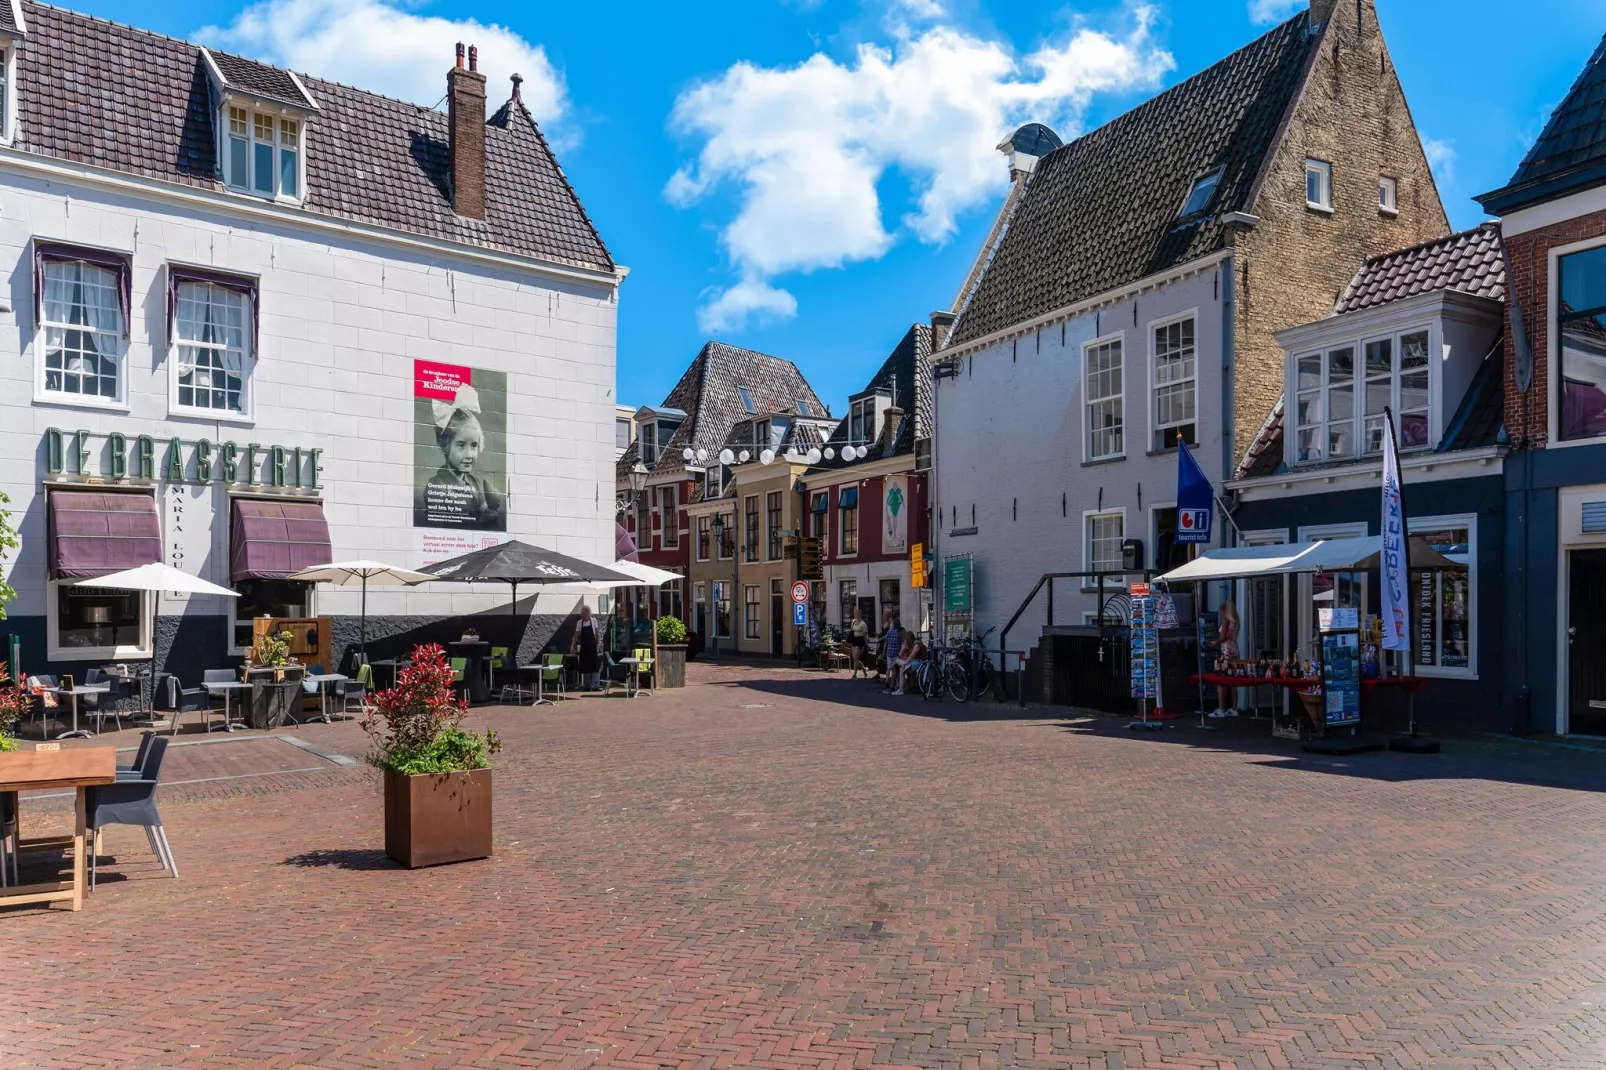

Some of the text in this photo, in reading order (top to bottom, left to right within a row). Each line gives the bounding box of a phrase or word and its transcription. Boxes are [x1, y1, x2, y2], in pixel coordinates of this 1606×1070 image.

[433, 376, 460, 387] Joodse
[172, 487, 184, 597] MARIA LOUE
[797, 604, 804, 616] P
[1421, 572, 1432, 664] ONTDEK FRIESLAND
